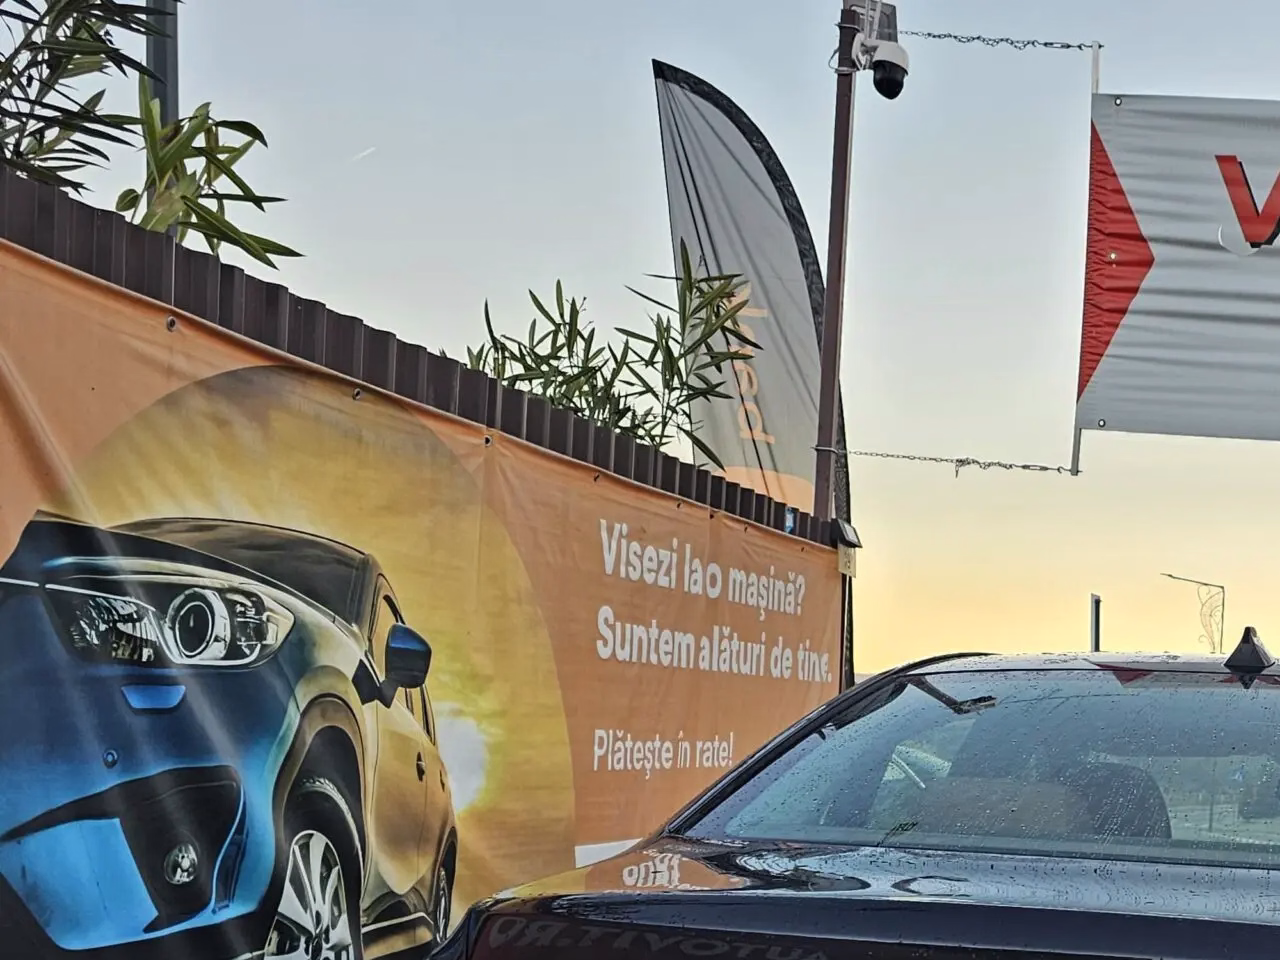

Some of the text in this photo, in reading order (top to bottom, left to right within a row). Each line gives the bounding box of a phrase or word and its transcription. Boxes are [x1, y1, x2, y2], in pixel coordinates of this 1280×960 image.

[599, 518, 679, 590] Visezi
[596, 605, 832, 683] Suntem alături de tine.
[677, 730, 690, 769] în
[695, 731, 734, 768] rate!
